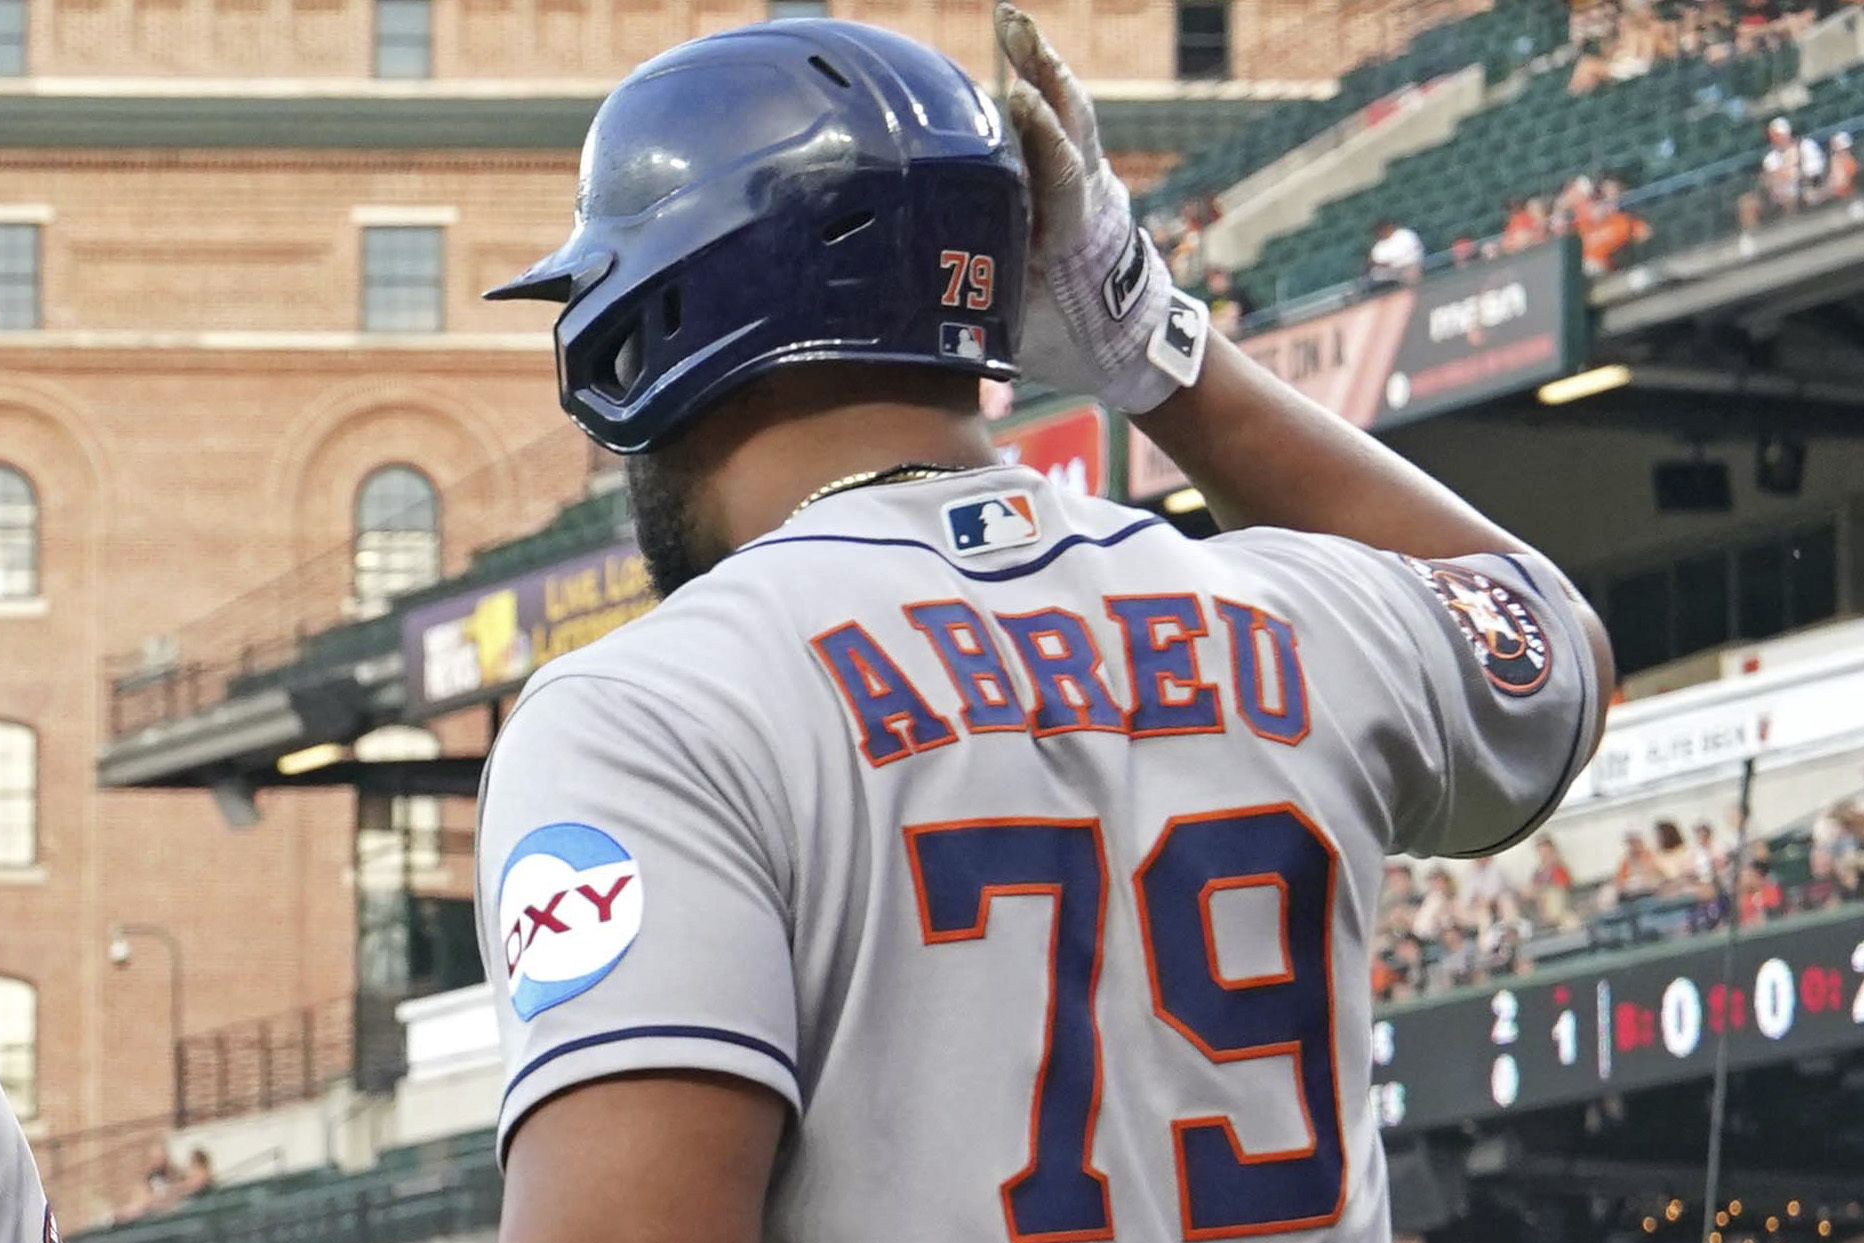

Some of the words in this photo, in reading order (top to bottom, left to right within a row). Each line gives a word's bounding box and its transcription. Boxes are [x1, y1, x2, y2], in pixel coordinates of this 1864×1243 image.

[940, 250, 994, 310] 79
[810, 592, 1311, 767] ABREU
[505, 873, 635, 979] OXY
[1491, 989, 1519, 1045] 2
[1552, 1009, 1577, 1066] 1
[1661, 976, 1702, 1059] 0
[1754, 957, 1795, 1040] 0
